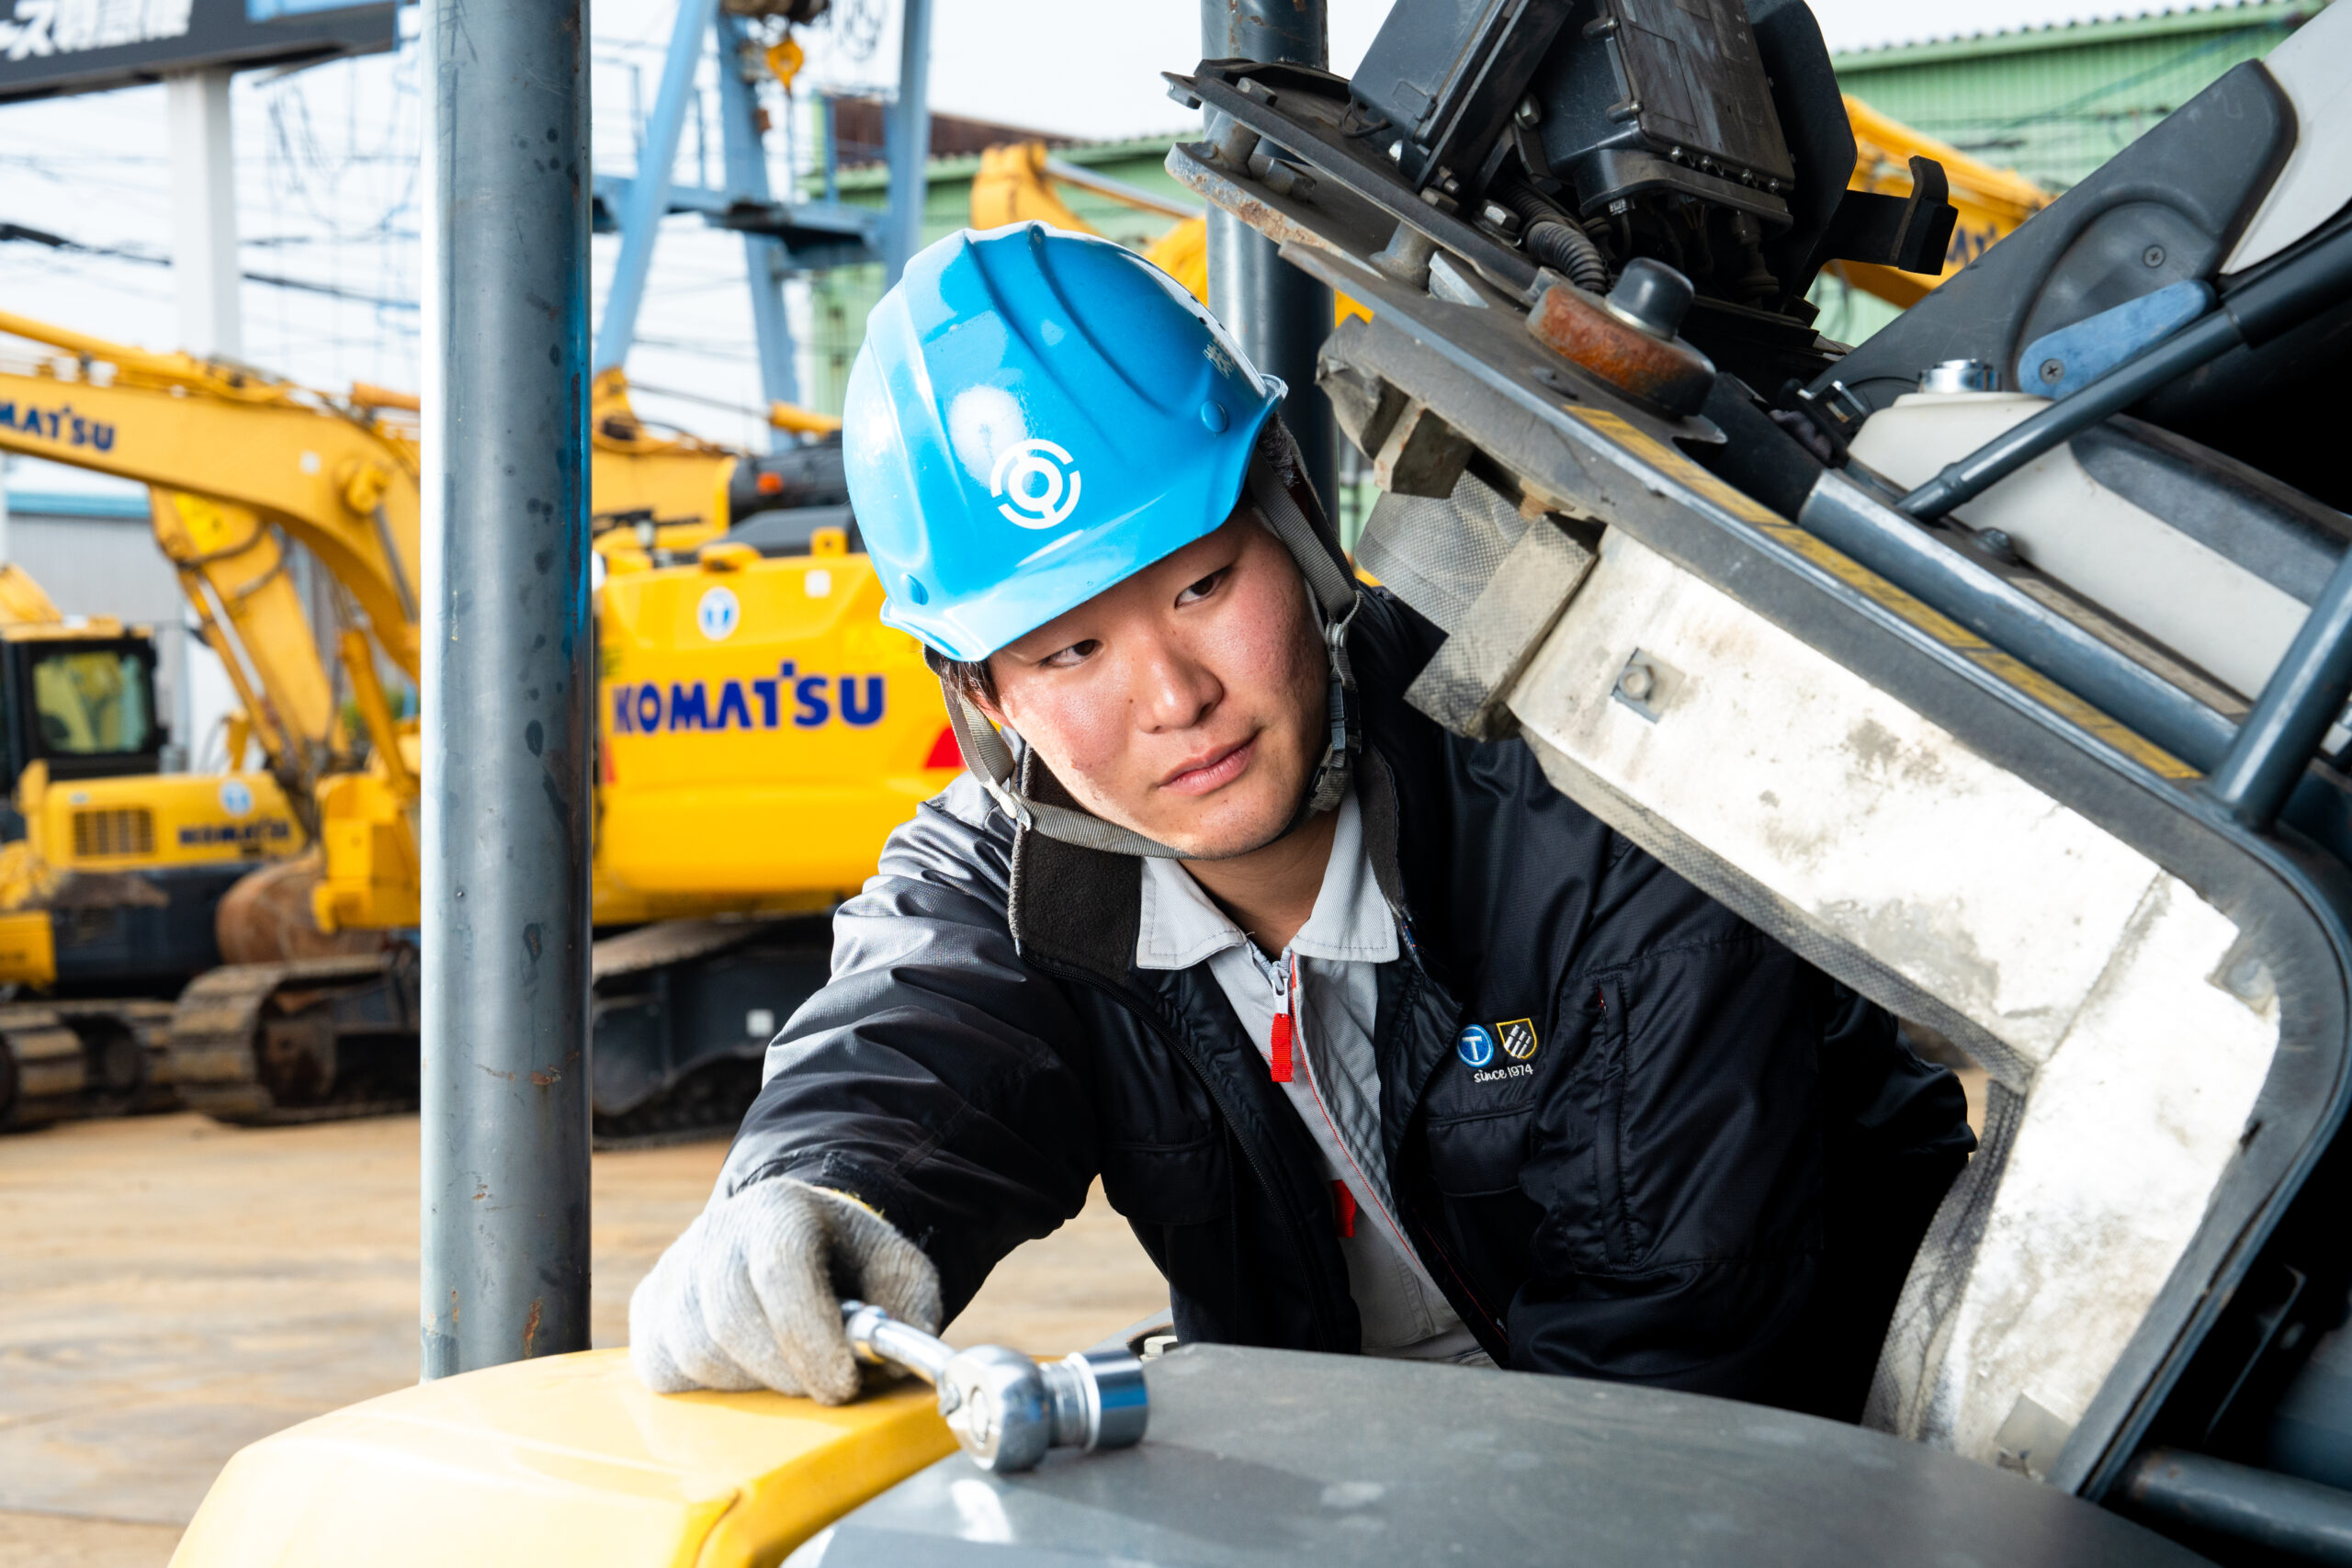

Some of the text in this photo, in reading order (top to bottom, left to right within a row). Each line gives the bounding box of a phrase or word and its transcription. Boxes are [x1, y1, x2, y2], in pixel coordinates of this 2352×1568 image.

[613, 659, 884, 734] KOMATSU
[1462, 1035, 1483, 1061] T
[1473, 1063, 1534, 1083] since 1974
